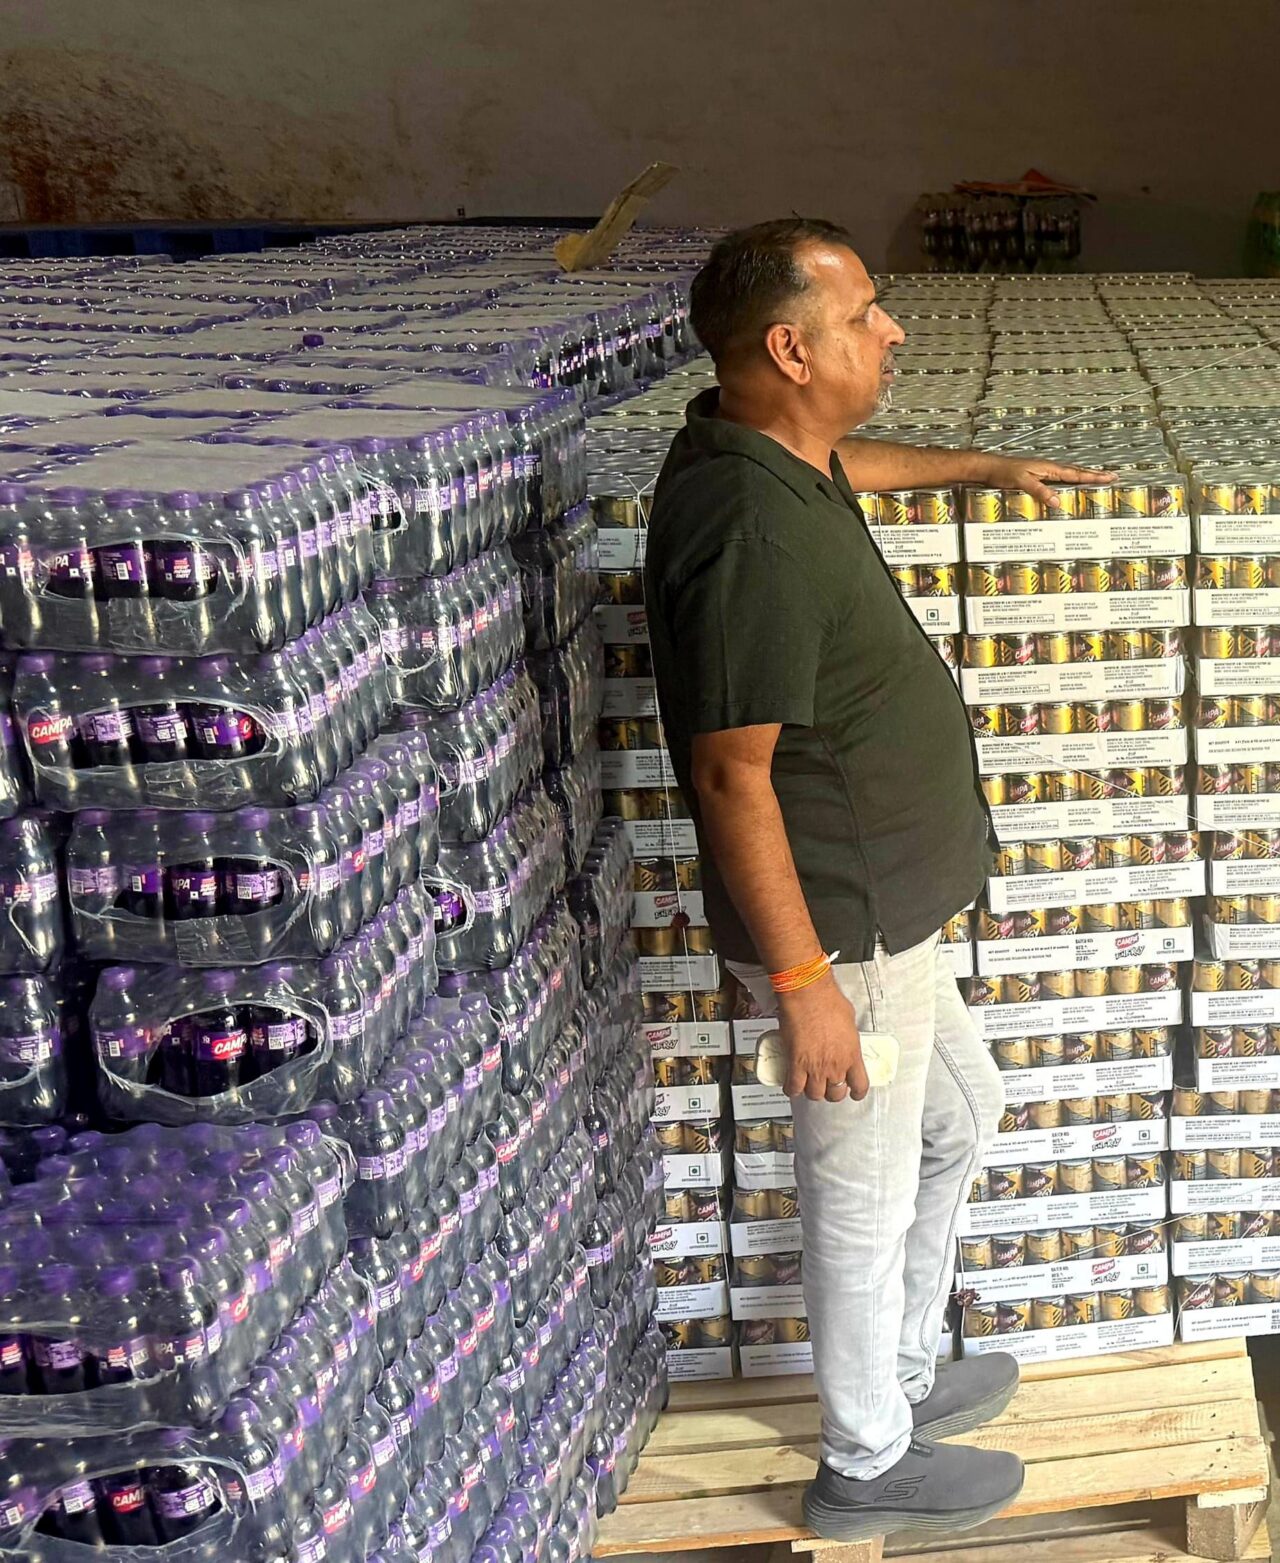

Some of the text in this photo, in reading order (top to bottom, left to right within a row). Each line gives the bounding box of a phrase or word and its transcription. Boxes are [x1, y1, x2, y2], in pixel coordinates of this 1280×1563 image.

[31, 715, 73, 739] CAMPA
[647, 1028, 671, 1040] CAMPA
[498, 1139, 520, 1158] CAM
[113, 1489, 144, 1507] CAM
